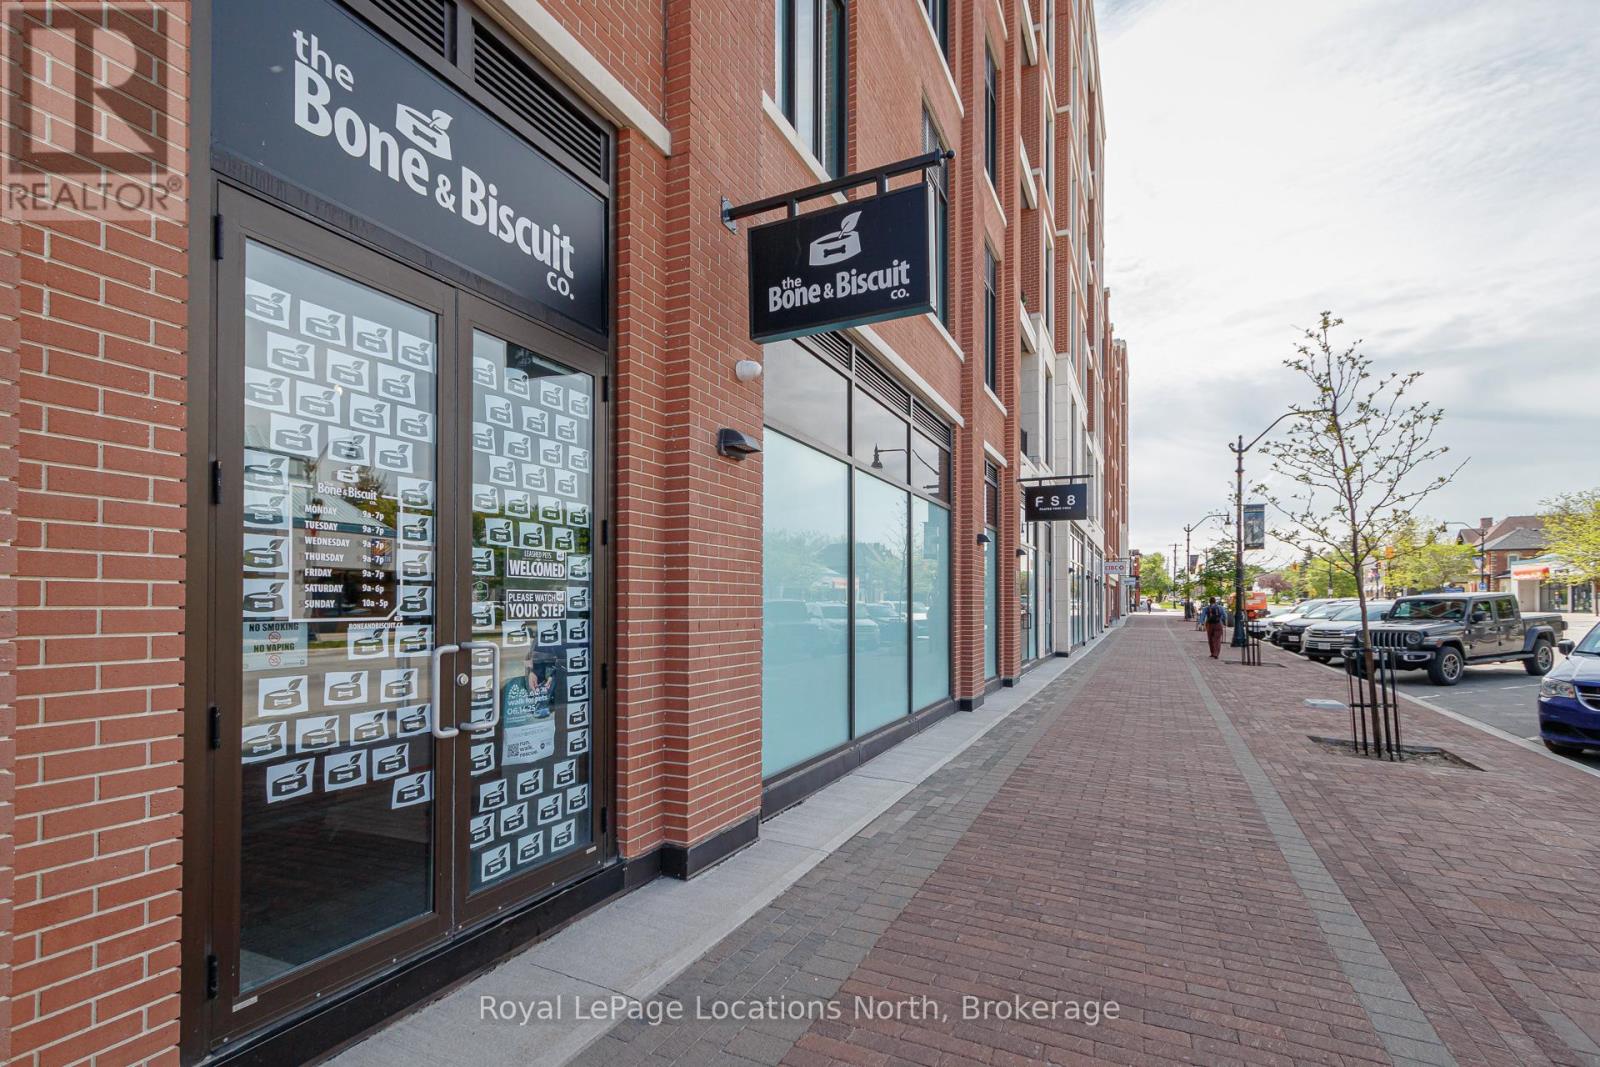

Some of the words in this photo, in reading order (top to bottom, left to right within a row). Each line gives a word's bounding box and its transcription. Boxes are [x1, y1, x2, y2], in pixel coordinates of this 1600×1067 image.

[292, 29, 354, 92] the
[294, 60, 429, 196] Bone
[434, 174, 456, 213] &
[461, 165, 575, 279] Biscuit
[768, 284, 821, 313] Bone
[823, 283, 835, 299] &
[836, 259, 911, 299] Biscuit
[781, 277, 802, 291] the
[317, 482, 342, 496] Bone
[348, 487, 378, 501] Biscuit
[304, 504, 338, 516] MONDAY
[304, 520, 338, 531] TUESDAY
[304, 536, 351, 547] WEDNESDAY
[304, 552, 345, 562] THURSDAY
[304, 568, 333, 577] FRIDAY
[509, 560, 565, 578] WELCOMED
[304, 583, 344, 593] SATURDAY
[508, 593, 534, 602] PLEASE
[535, 593, 556, 602] WATCH
[304, 599, 336, 609] SUNDAY
[508, 603, 539, 618] YOUR
[541, 603, 565, 617] STEP
[249, 623, 261, 632] NO
[263, 622, 299, 632] SMOKING
[253, 644, 265, 653] NO
[267, 643, 295, 652] VAPING
